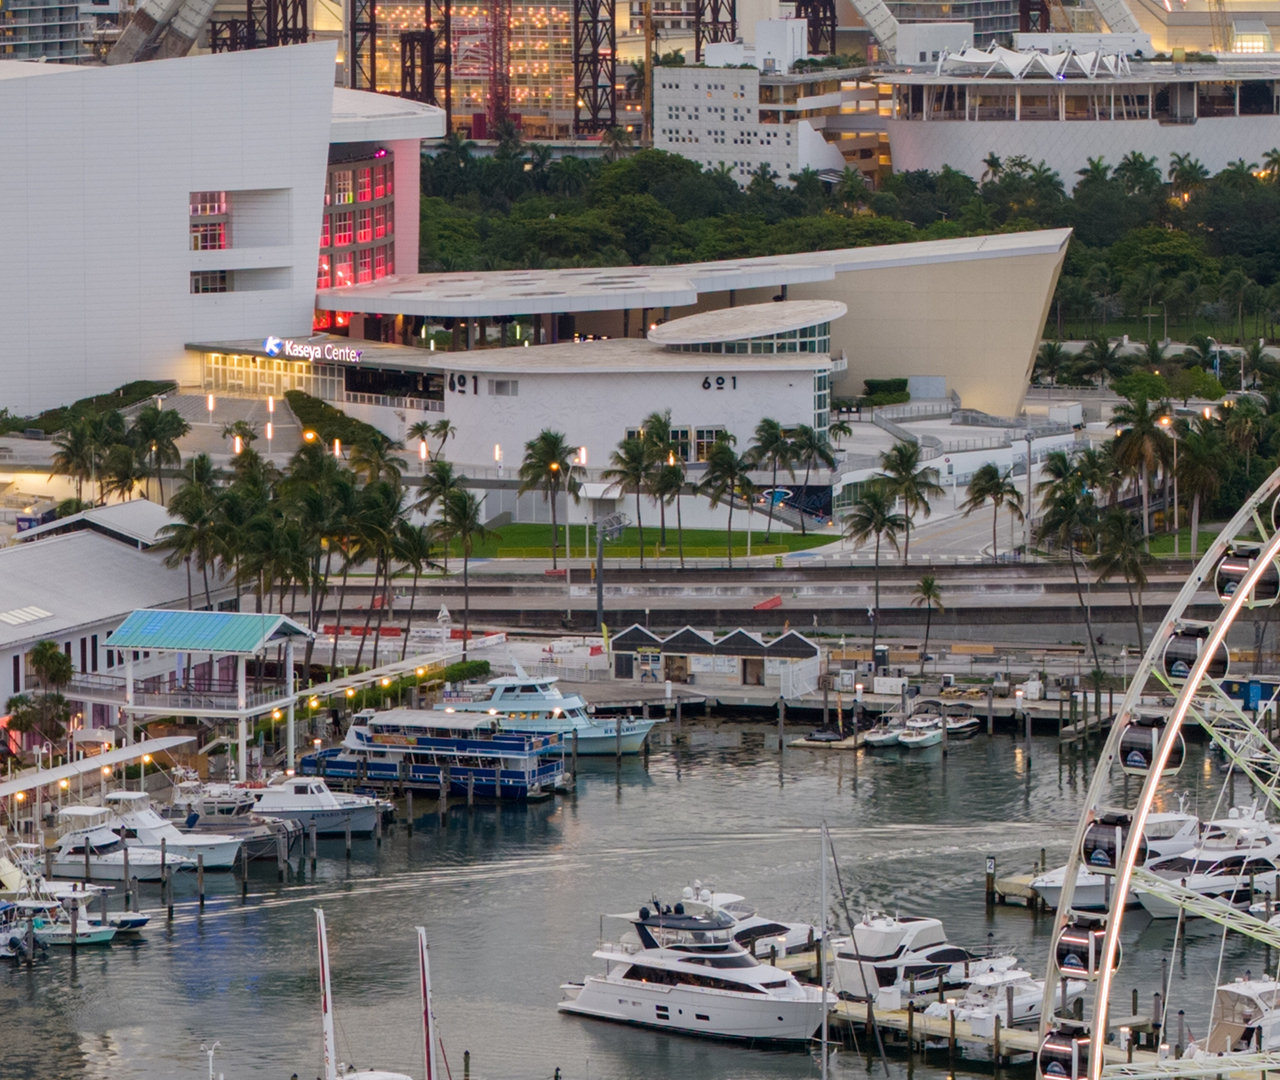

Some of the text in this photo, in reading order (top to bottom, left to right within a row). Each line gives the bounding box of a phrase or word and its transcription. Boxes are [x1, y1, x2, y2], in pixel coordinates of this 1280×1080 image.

[285, 340, 322, 361] Kaseya
[324, 344, 363, 362] Center
[702, 376, 737, 390] 601
